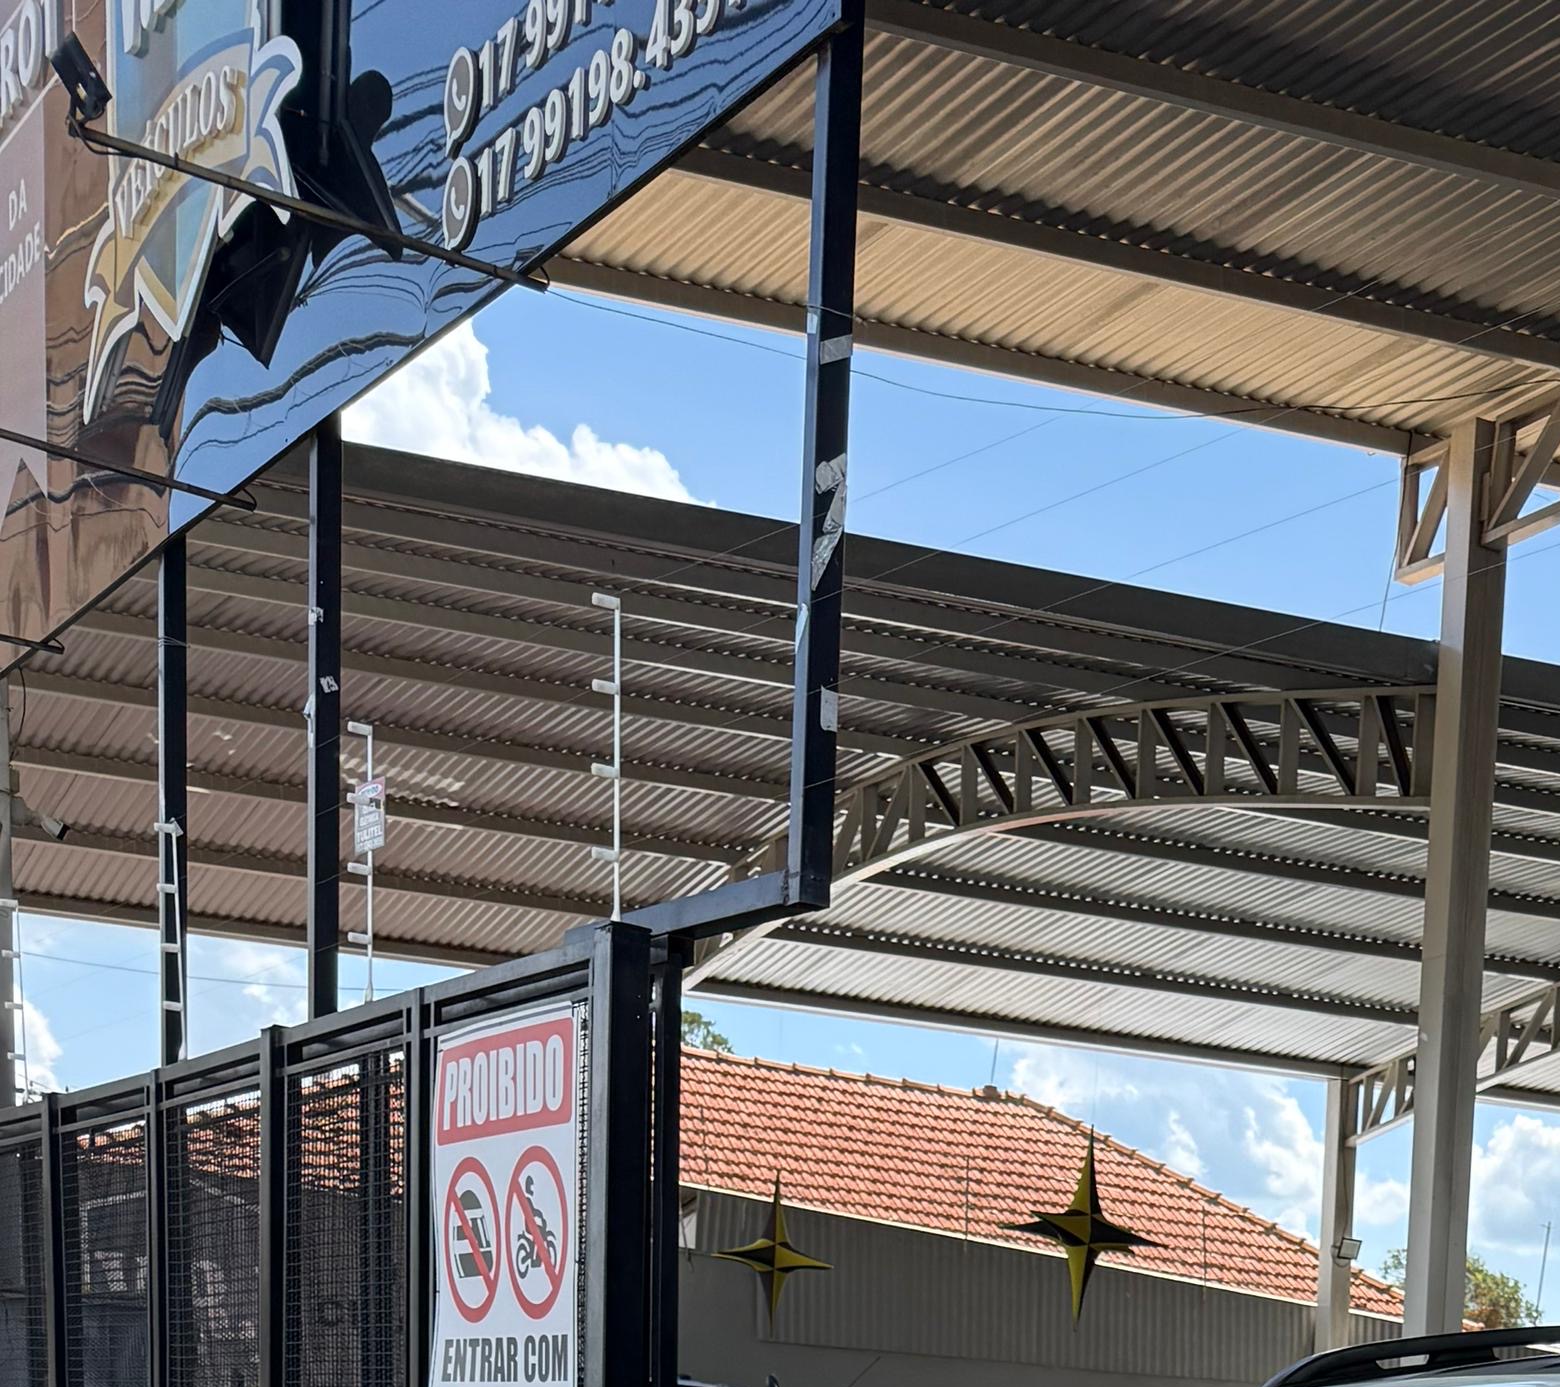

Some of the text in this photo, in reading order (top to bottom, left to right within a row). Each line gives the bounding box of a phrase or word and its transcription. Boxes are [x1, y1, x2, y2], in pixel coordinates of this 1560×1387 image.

[477, 0, 740, 217] 17 99198.43
[480, 17, 516, 110] 17
[9, 179, 27, 231] DA
[443, 1034, 564, 1131] PROIBIDO
[441, 1334, 568, 1382] ENTRAR COM
